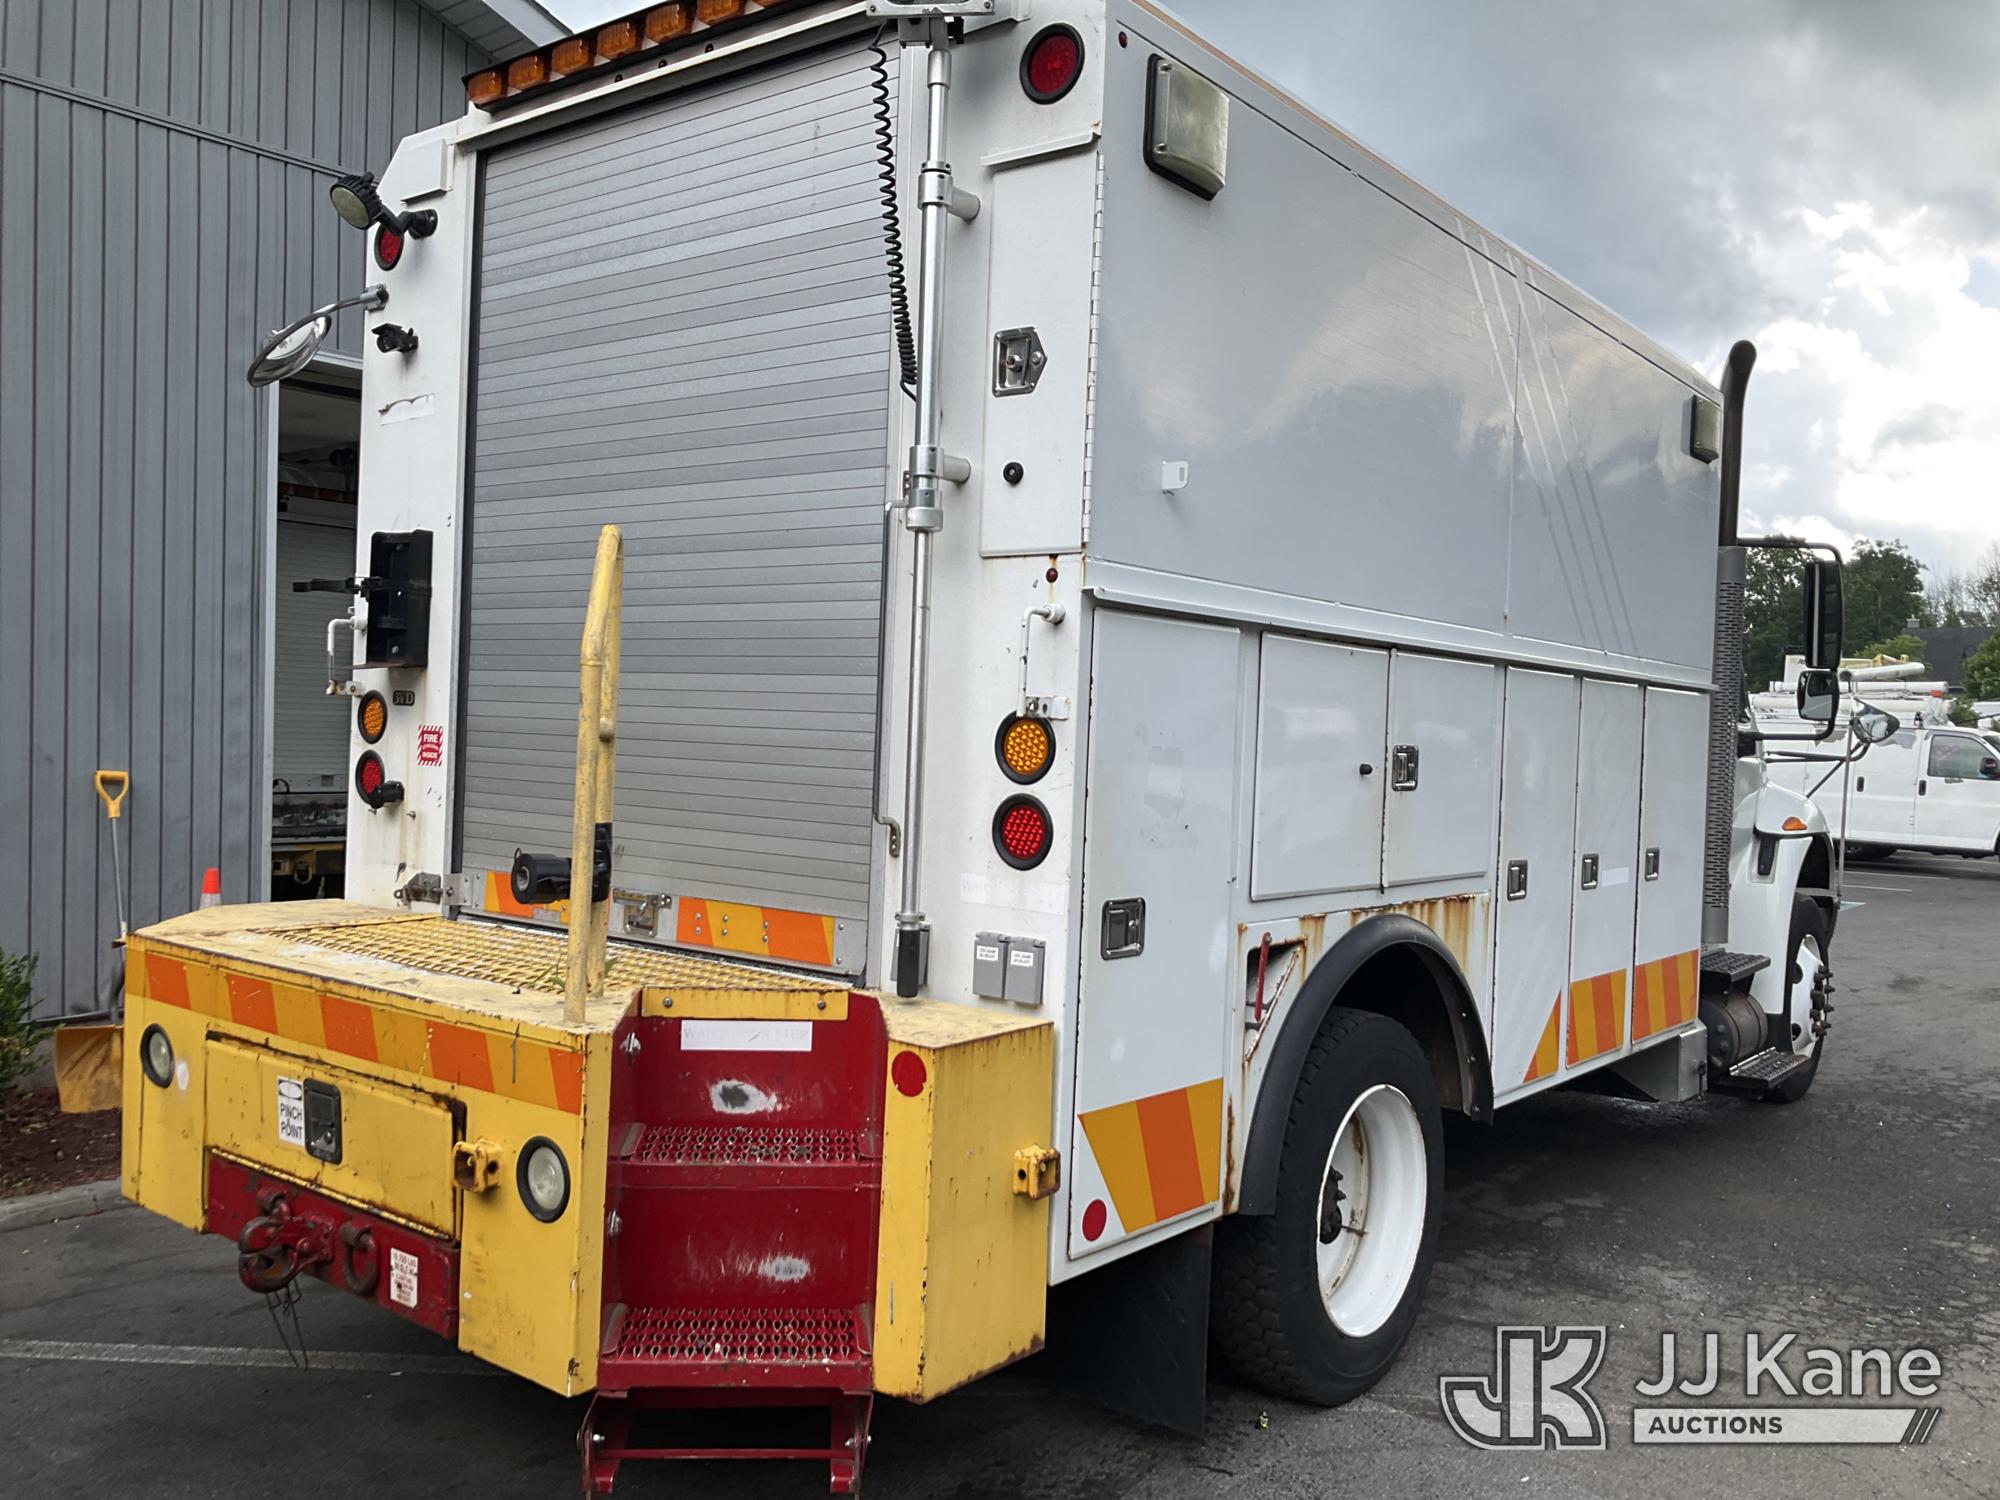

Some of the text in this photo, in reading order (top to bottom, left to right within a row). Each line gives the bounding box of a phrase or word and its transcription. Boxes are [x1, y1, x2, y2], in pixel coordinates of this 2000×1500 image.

[423, 733, 439, 743] FIRE
[280, 1103, 303, 1121] PINCH
[281, 1120, 303, 1140] POINT
